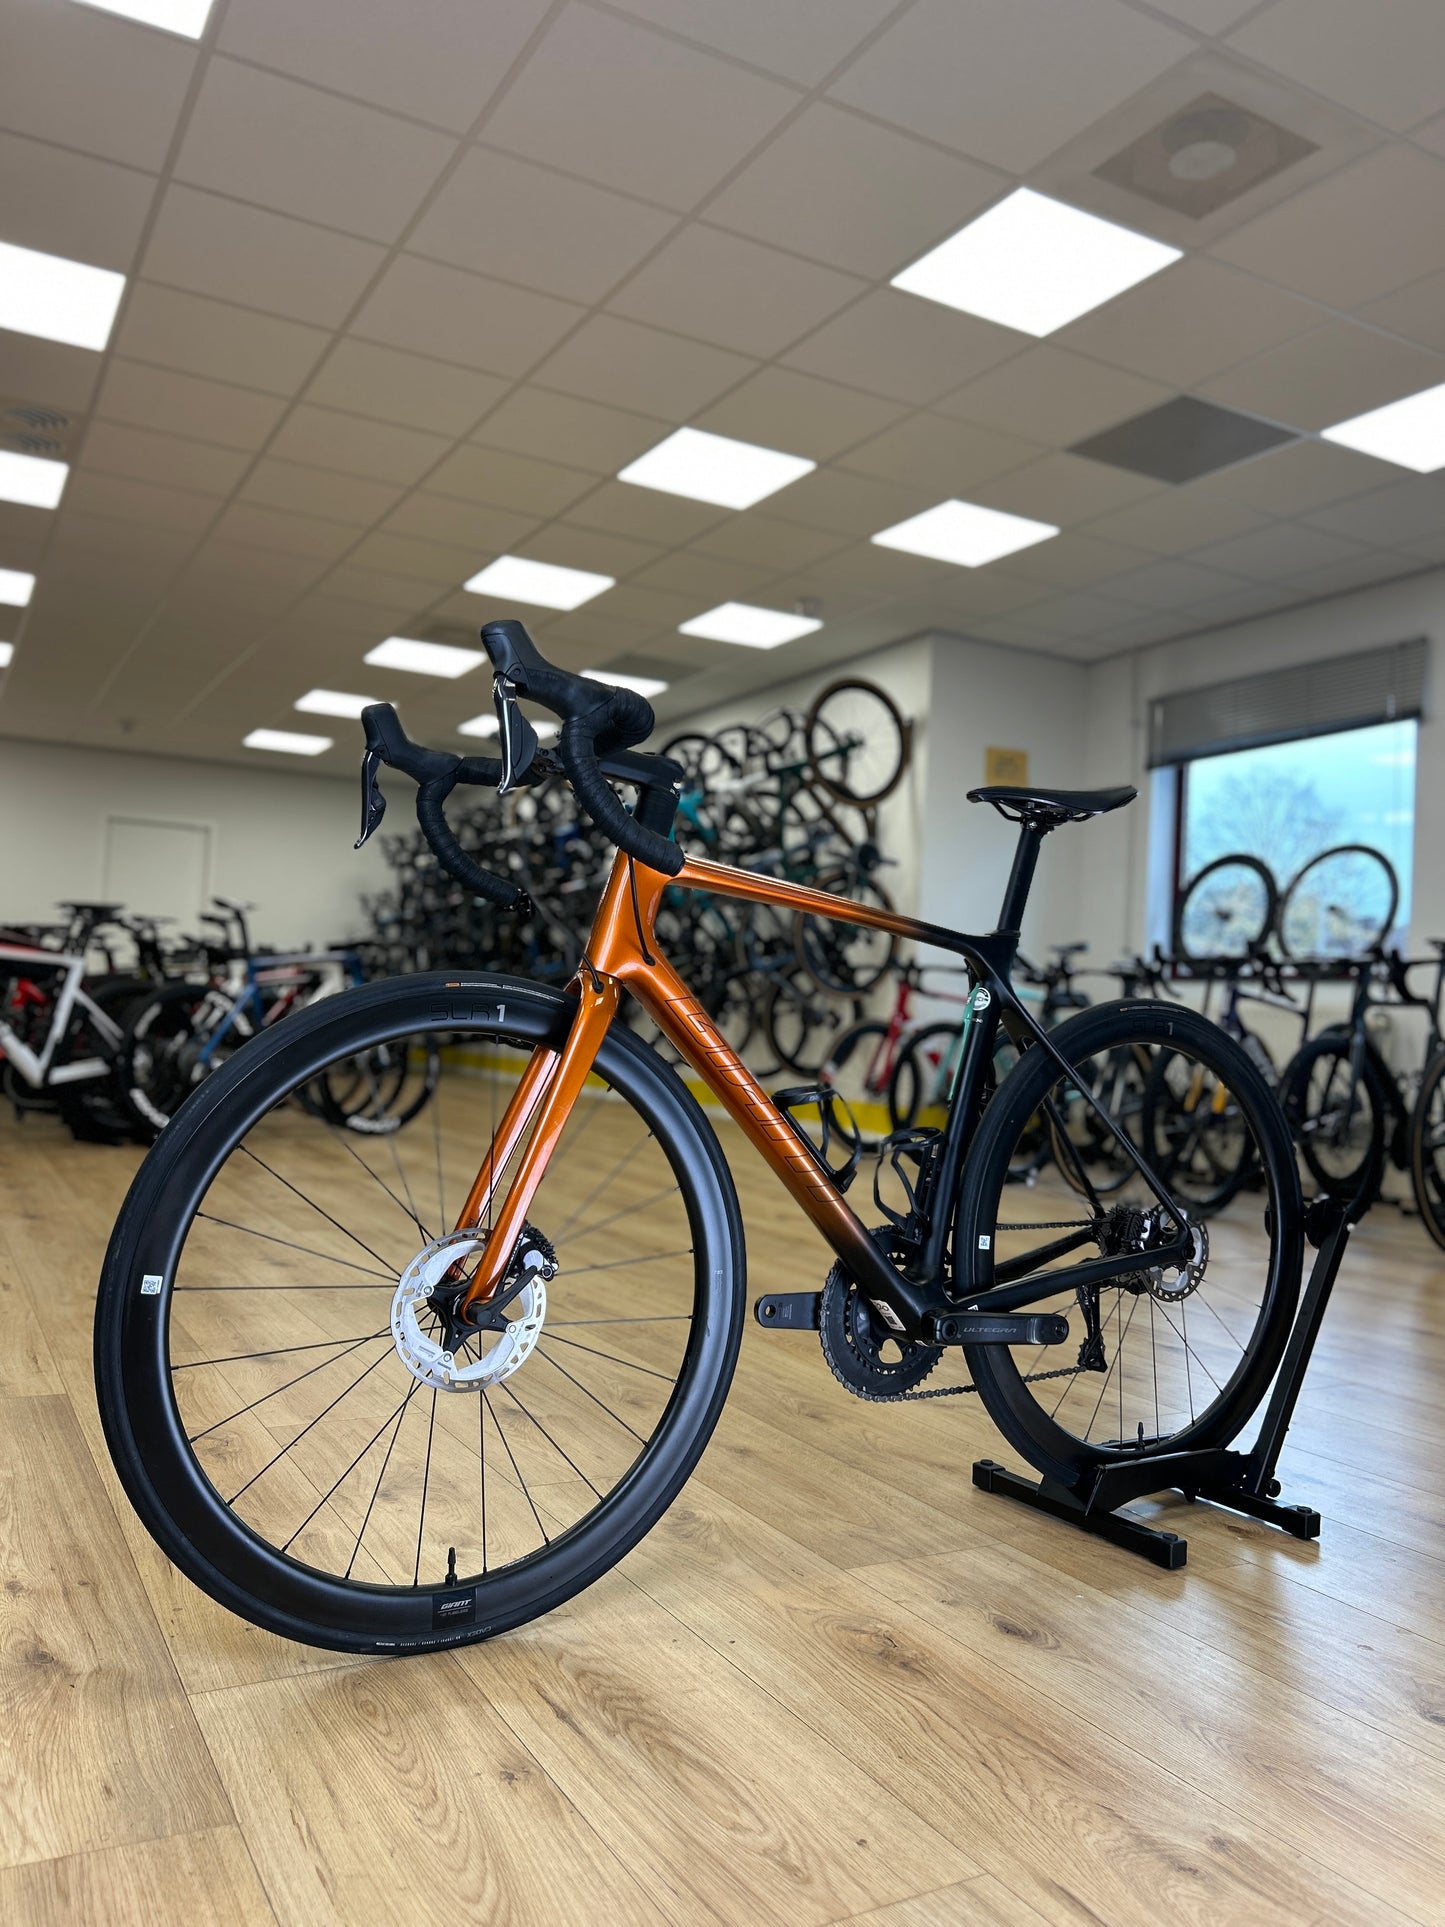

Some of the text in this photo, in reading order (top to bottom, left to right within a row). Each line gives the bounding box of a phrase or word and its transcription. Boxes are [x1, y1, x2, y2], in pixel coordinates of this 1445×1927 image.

[431, 1003, 506, 1023] SLR 1
[441, 1599, 472, 1610] GIANT
